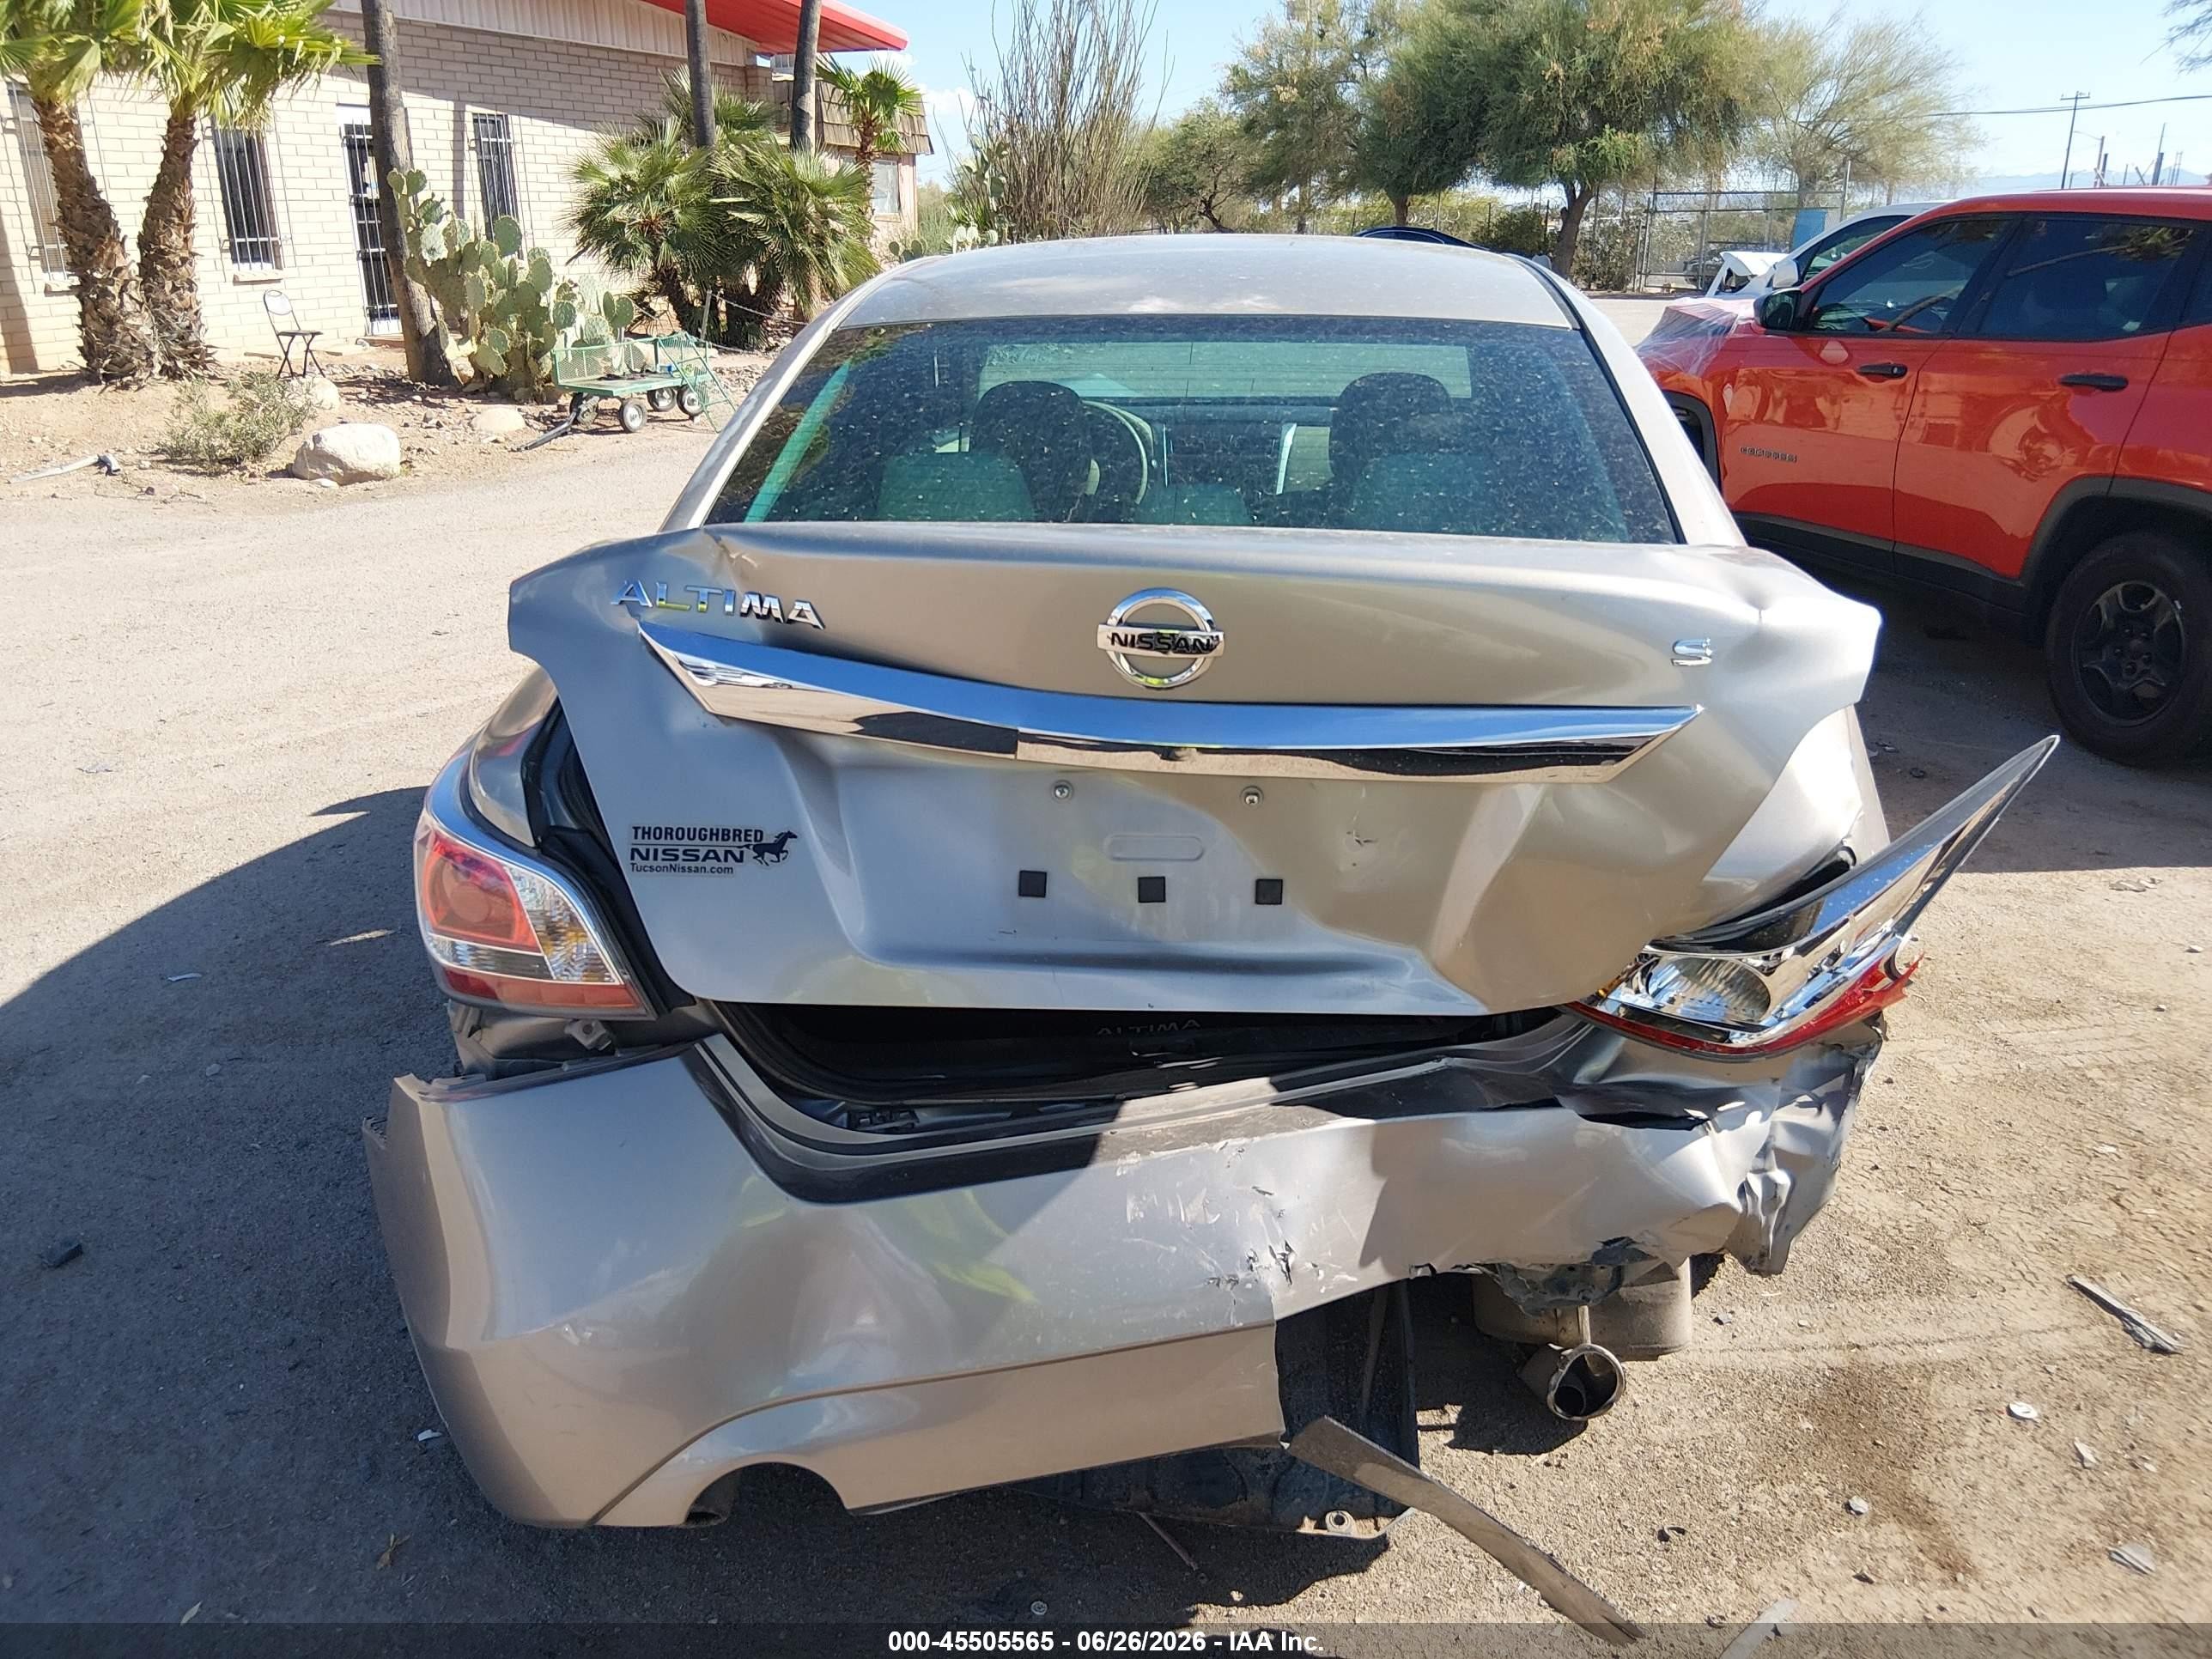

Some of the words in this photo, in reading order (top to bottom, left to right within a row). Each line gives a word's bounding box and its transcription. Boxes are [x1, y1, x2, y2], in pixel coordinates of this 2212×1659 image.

[611, 579, 826, 630] ALTIMA
[1110, 632, 1212, 653] NISSAN
[1670, 637, 1713, 666] S
[632, 826, 764, 842] THOROUGHBRED
[630, 848, 744, 863] NISSAN
[630, 862, 734, 874] TucsonNissan.com
